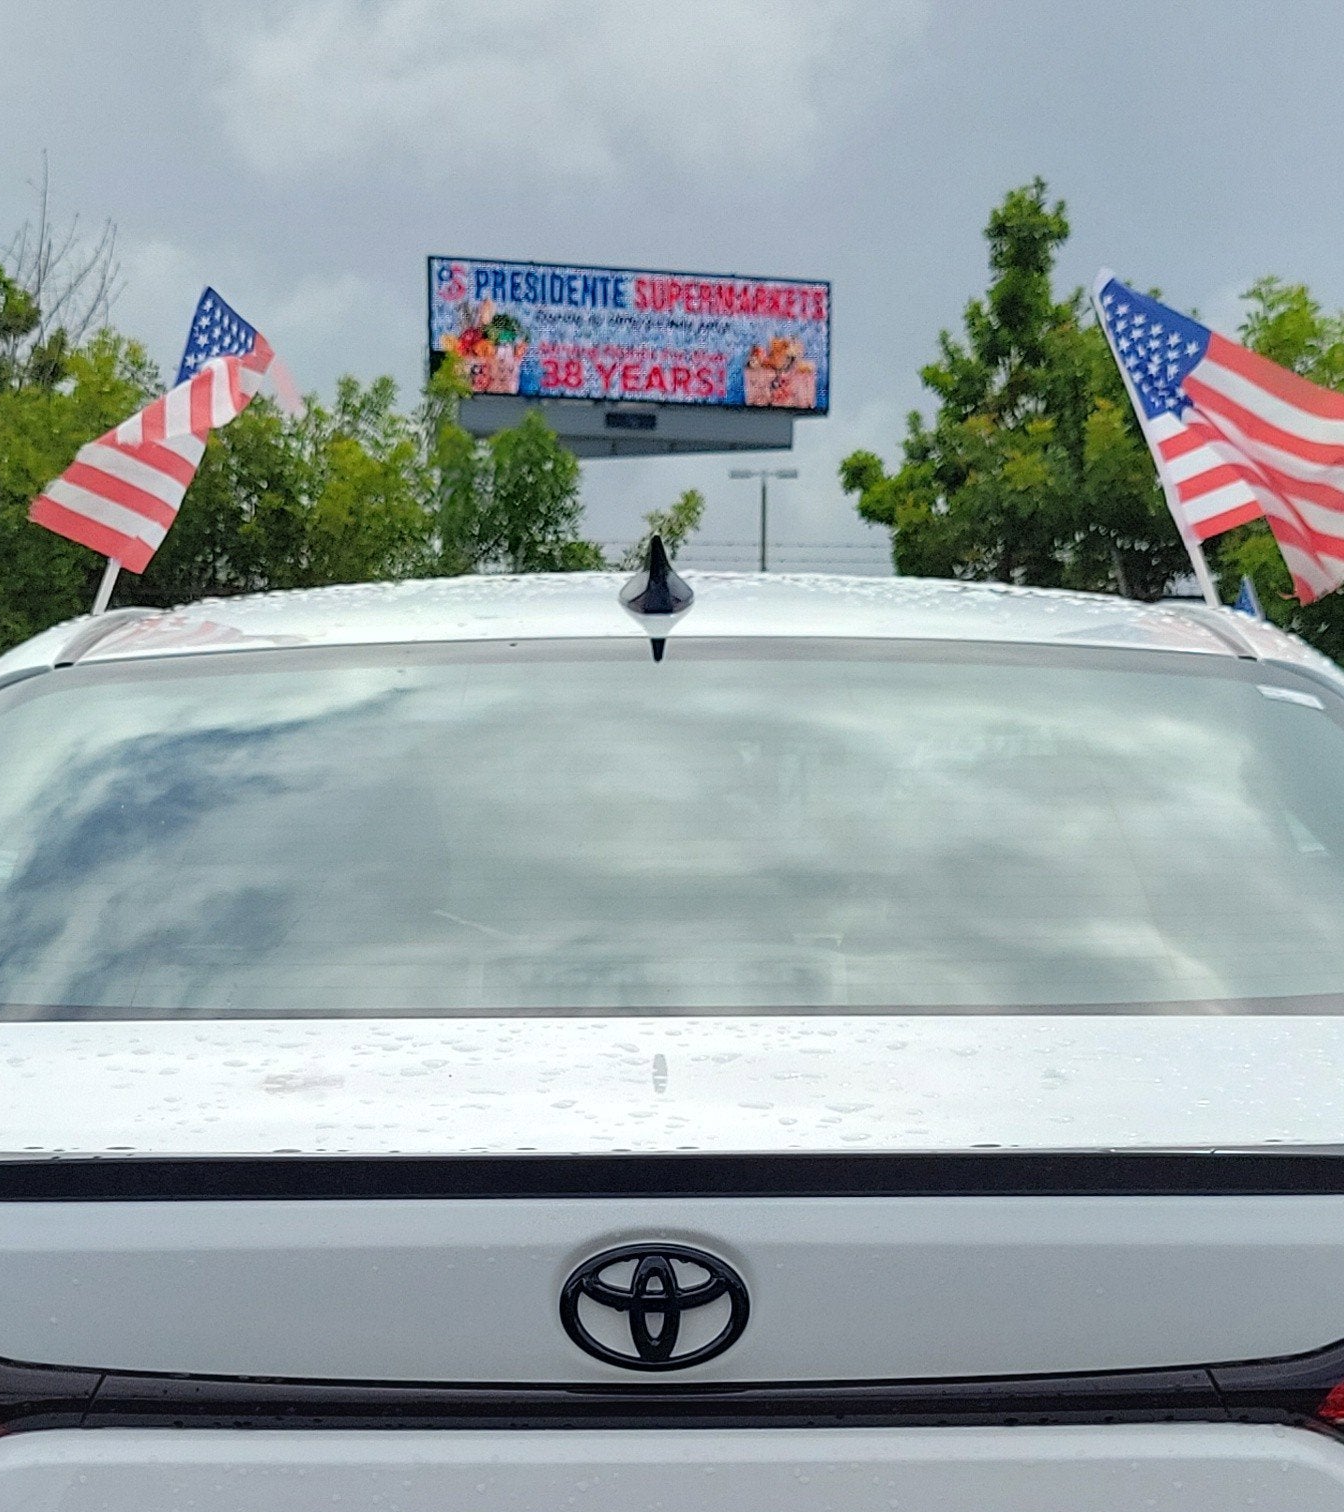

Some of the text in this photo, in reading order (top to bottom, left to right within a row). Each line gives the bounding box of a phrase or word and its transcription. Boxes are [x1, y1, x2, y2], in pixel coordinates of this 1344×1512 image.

[474, 268, 826, 320] PRESIDENTE SUPERMARKETS
[539, 358, 727, 398] 38 YEARS!
